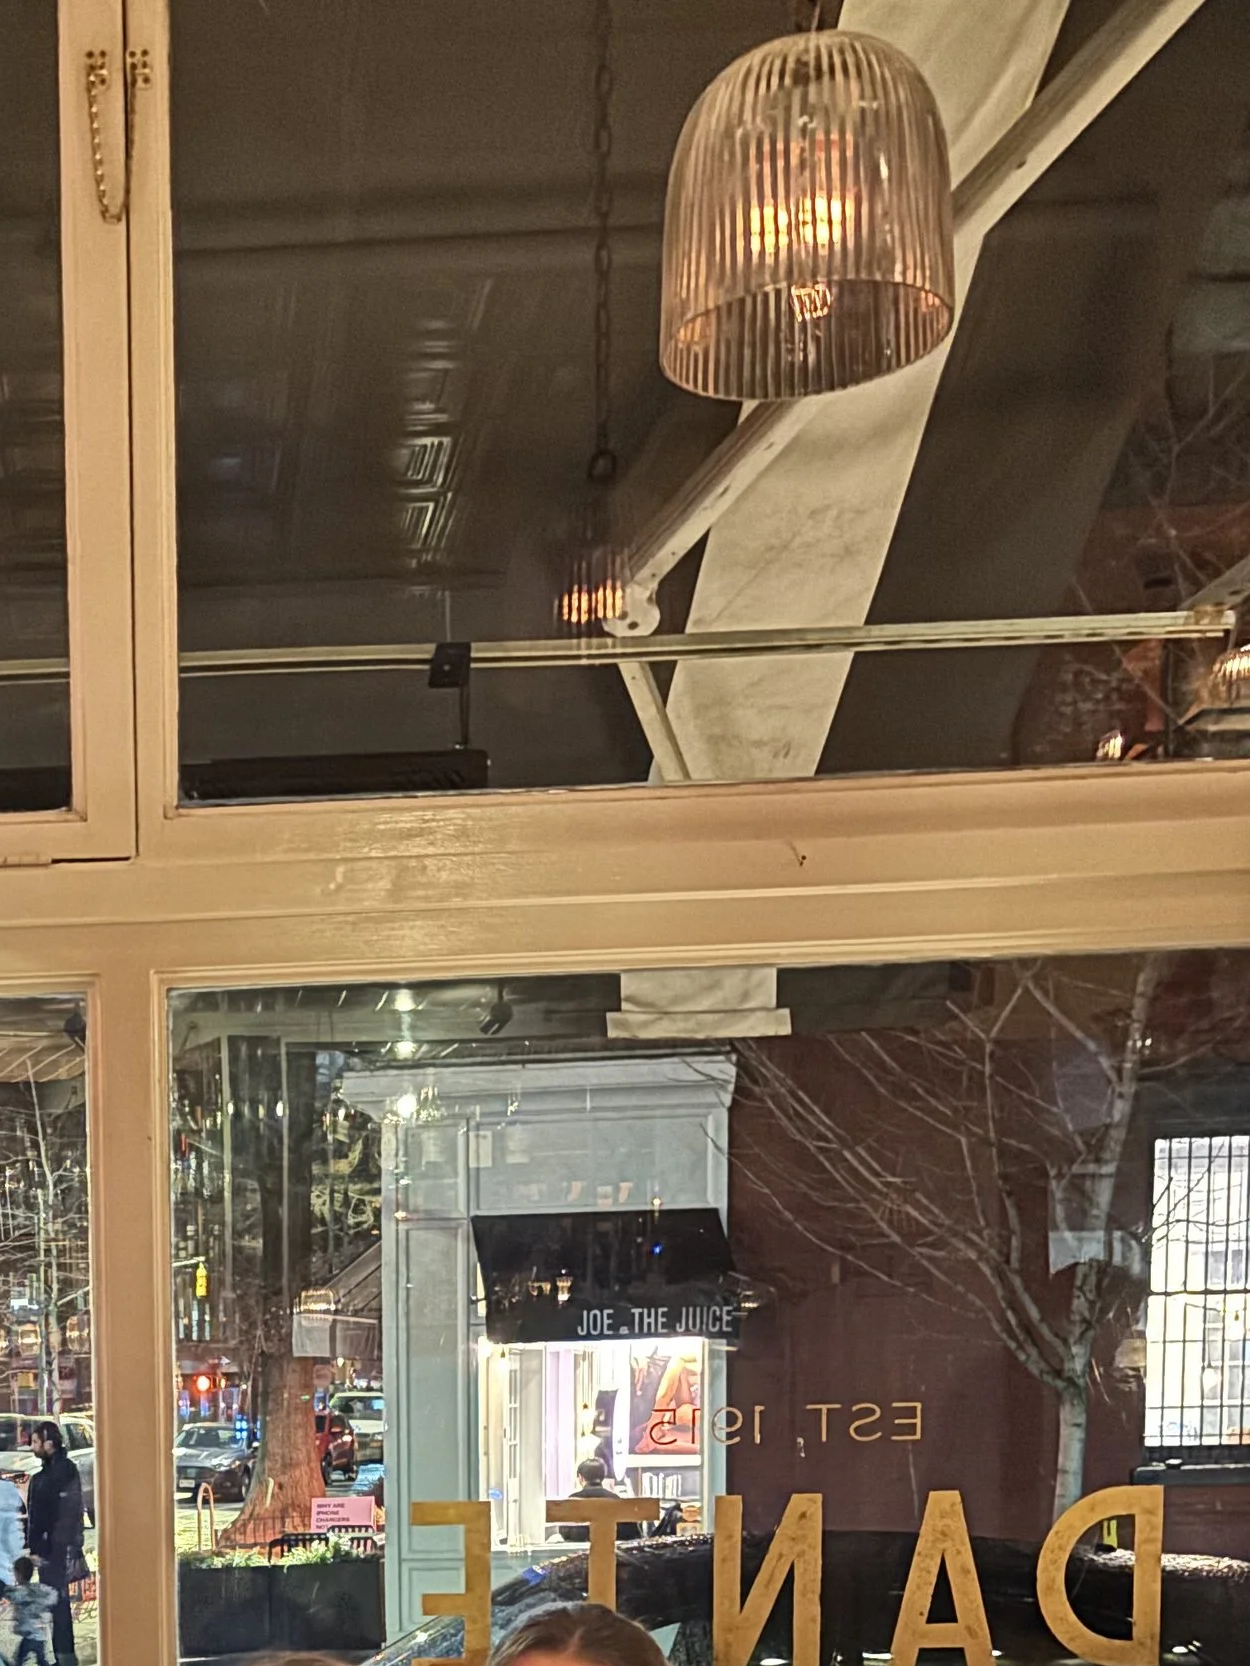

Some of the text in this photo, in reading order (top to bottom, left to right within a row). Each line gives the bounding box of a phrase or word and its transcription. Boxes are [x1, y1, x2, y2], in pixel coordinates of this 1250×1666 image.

[577, 1309, 614, 1336] JOE
[631, 1307, 669, 1333] THE
[676, 1305, 734, 1333] JUICE
